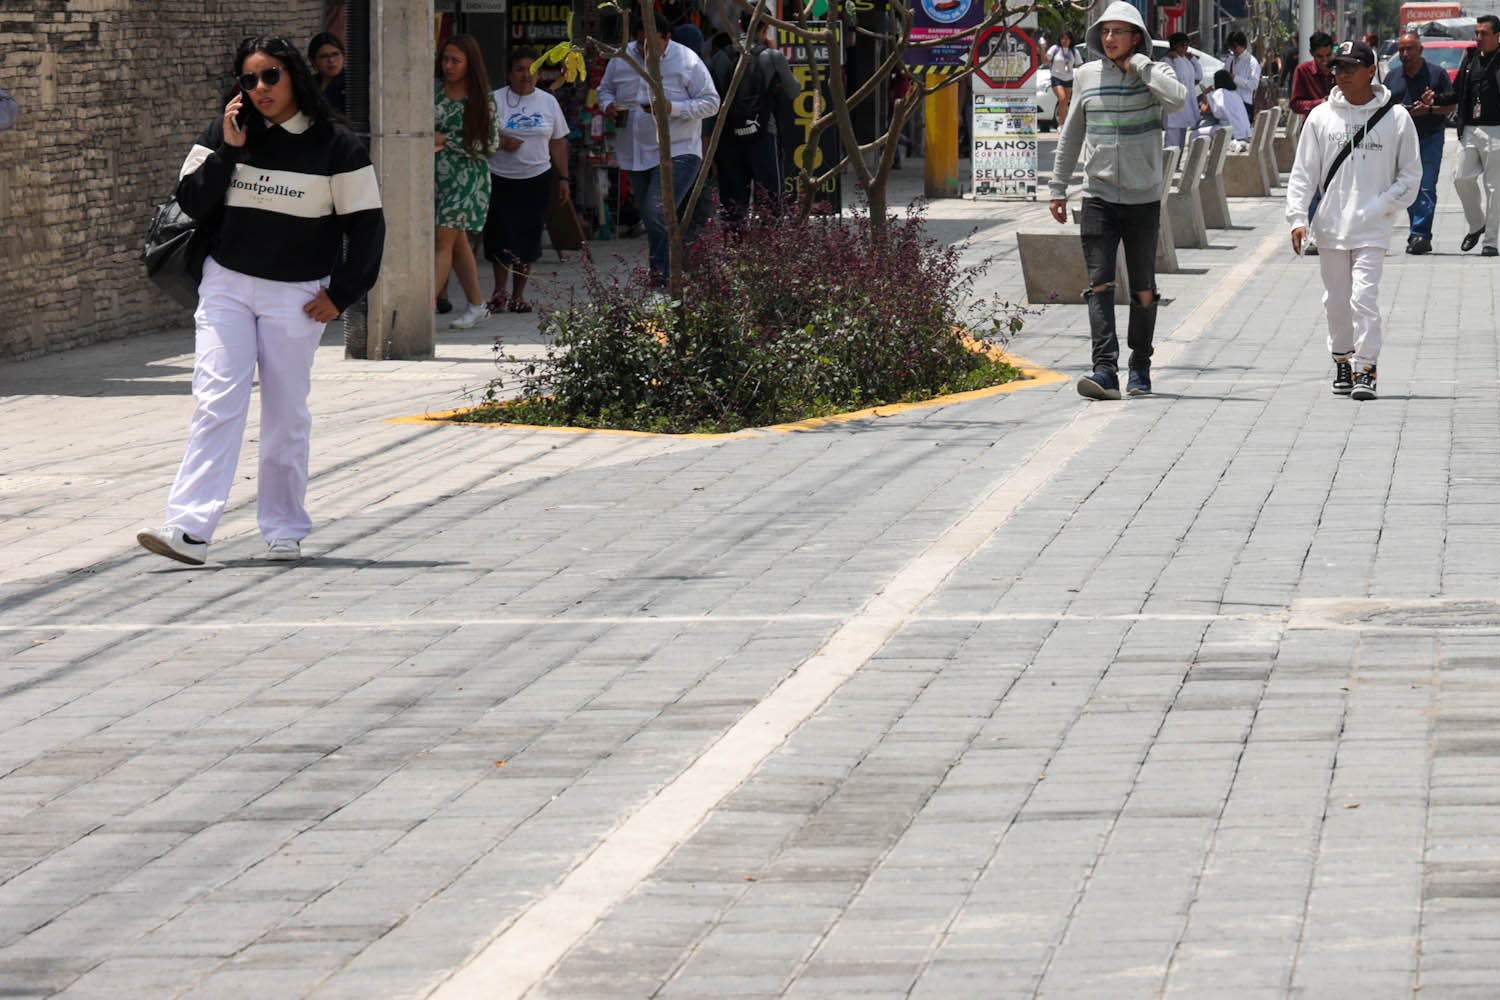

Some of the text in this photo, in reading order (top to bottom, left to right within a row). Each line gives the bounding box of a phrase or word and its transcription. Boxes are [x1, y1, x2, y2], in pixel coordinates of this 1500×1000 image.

[512, 2, 570, 22] TÍTULO
[975, 140, 1036, 150] PLANOS
[976, 169, 1036, 178] SELLOS
[784, 176, 836, 192] STIO
